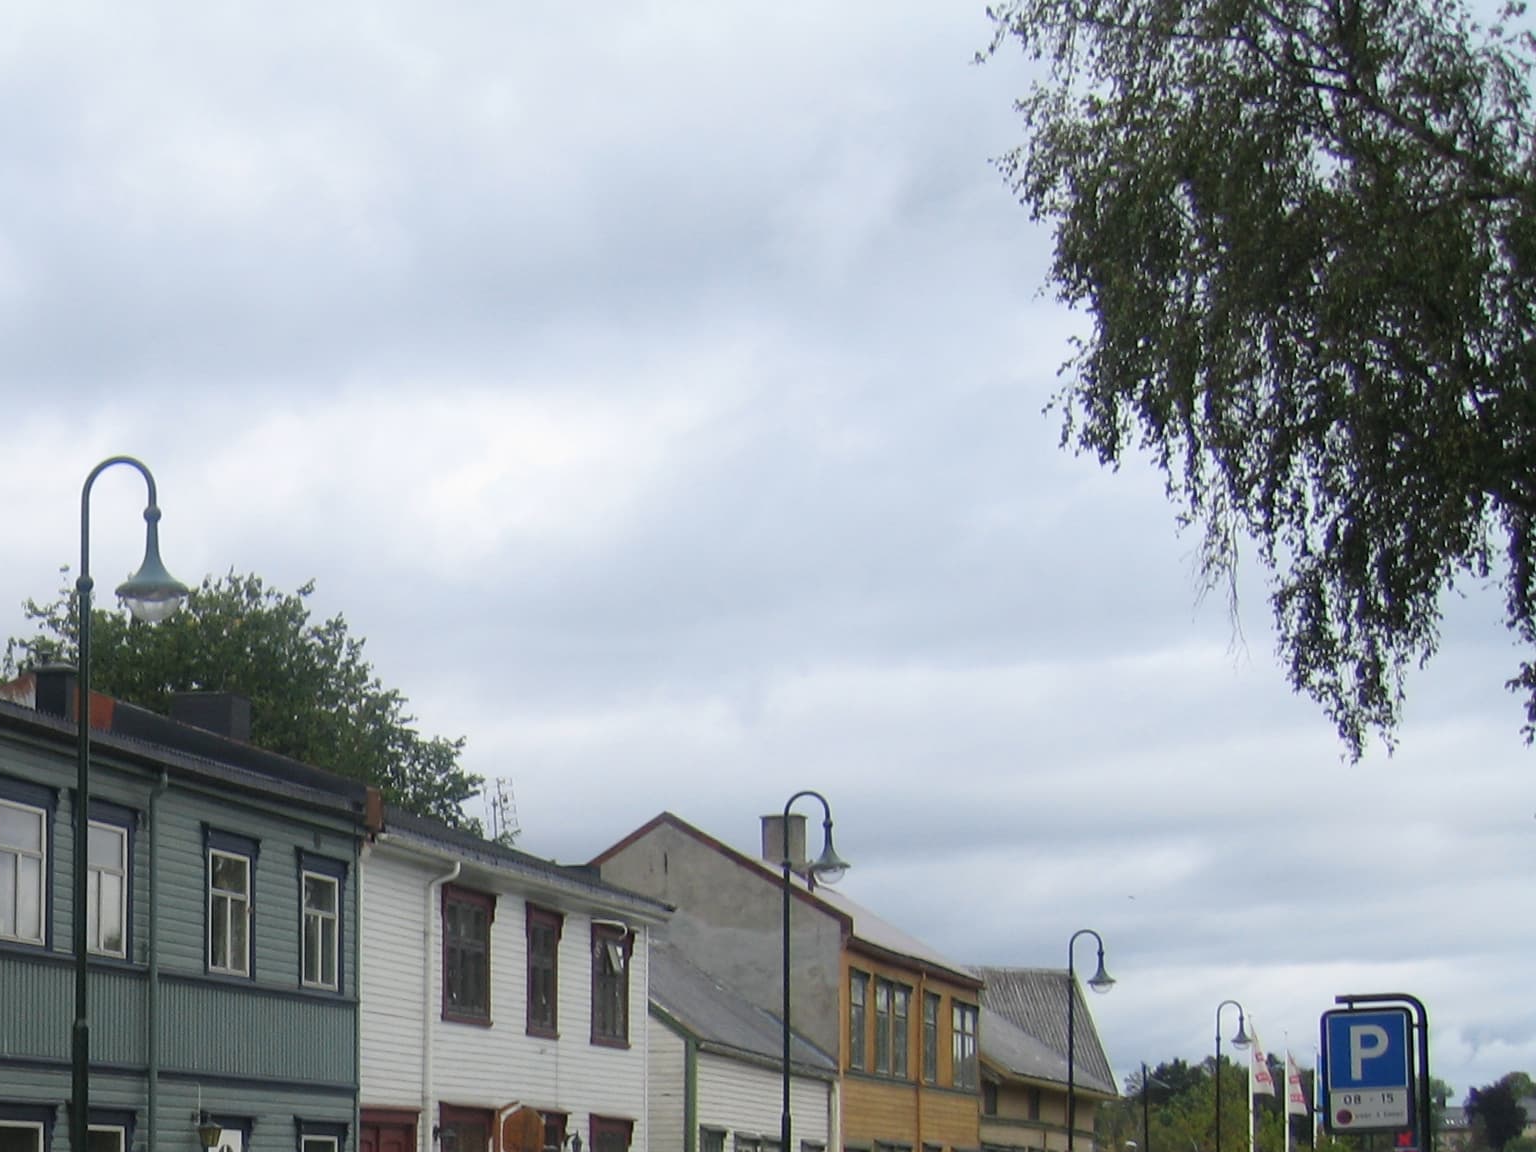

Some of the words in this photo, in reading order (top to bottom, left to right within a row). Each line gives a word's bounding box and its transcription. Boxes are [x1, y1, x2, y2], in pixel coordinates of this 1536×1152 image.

[1348, 1024, 1390, 1082] P
[1343, 1093, 1362, 1106] 08
[1381, 1092, 1395, 1105] 15
